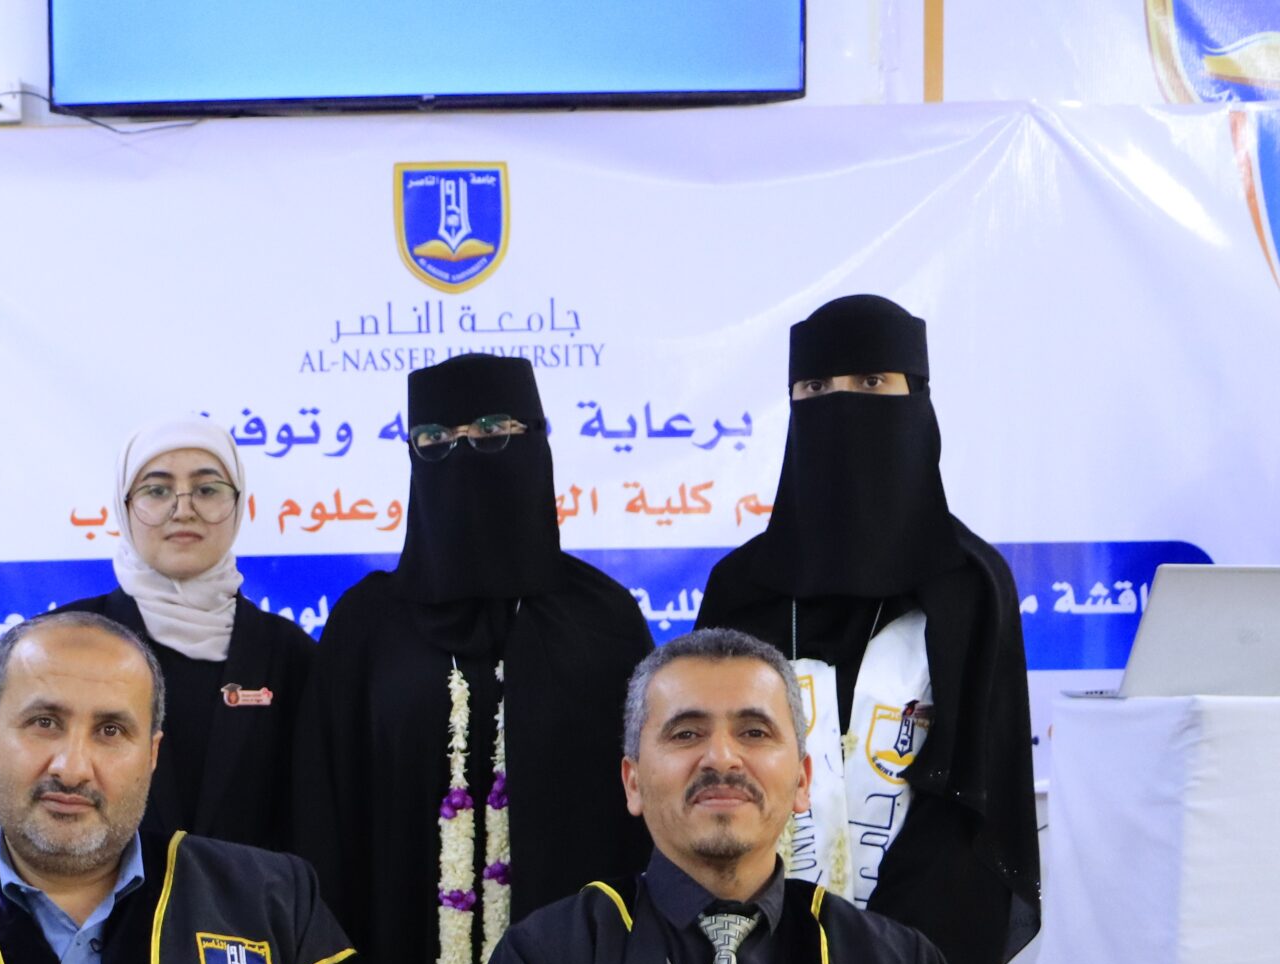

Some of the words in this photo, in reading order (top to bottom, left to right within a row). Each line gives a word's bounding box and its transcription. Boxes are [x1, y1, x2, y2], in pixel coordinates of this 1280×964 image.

[329, 300, 445, 344] الناصر
[459, 296, 582, 339] جامعة
[298, 347, 437, 373] AL-NASSER
[576, 400, 753, 454] برعاية
[277, 488, 404, 535] وعلوم
[624, 480, 715, 526] كلية
[1051, 580, 1150, 616] اقشة
